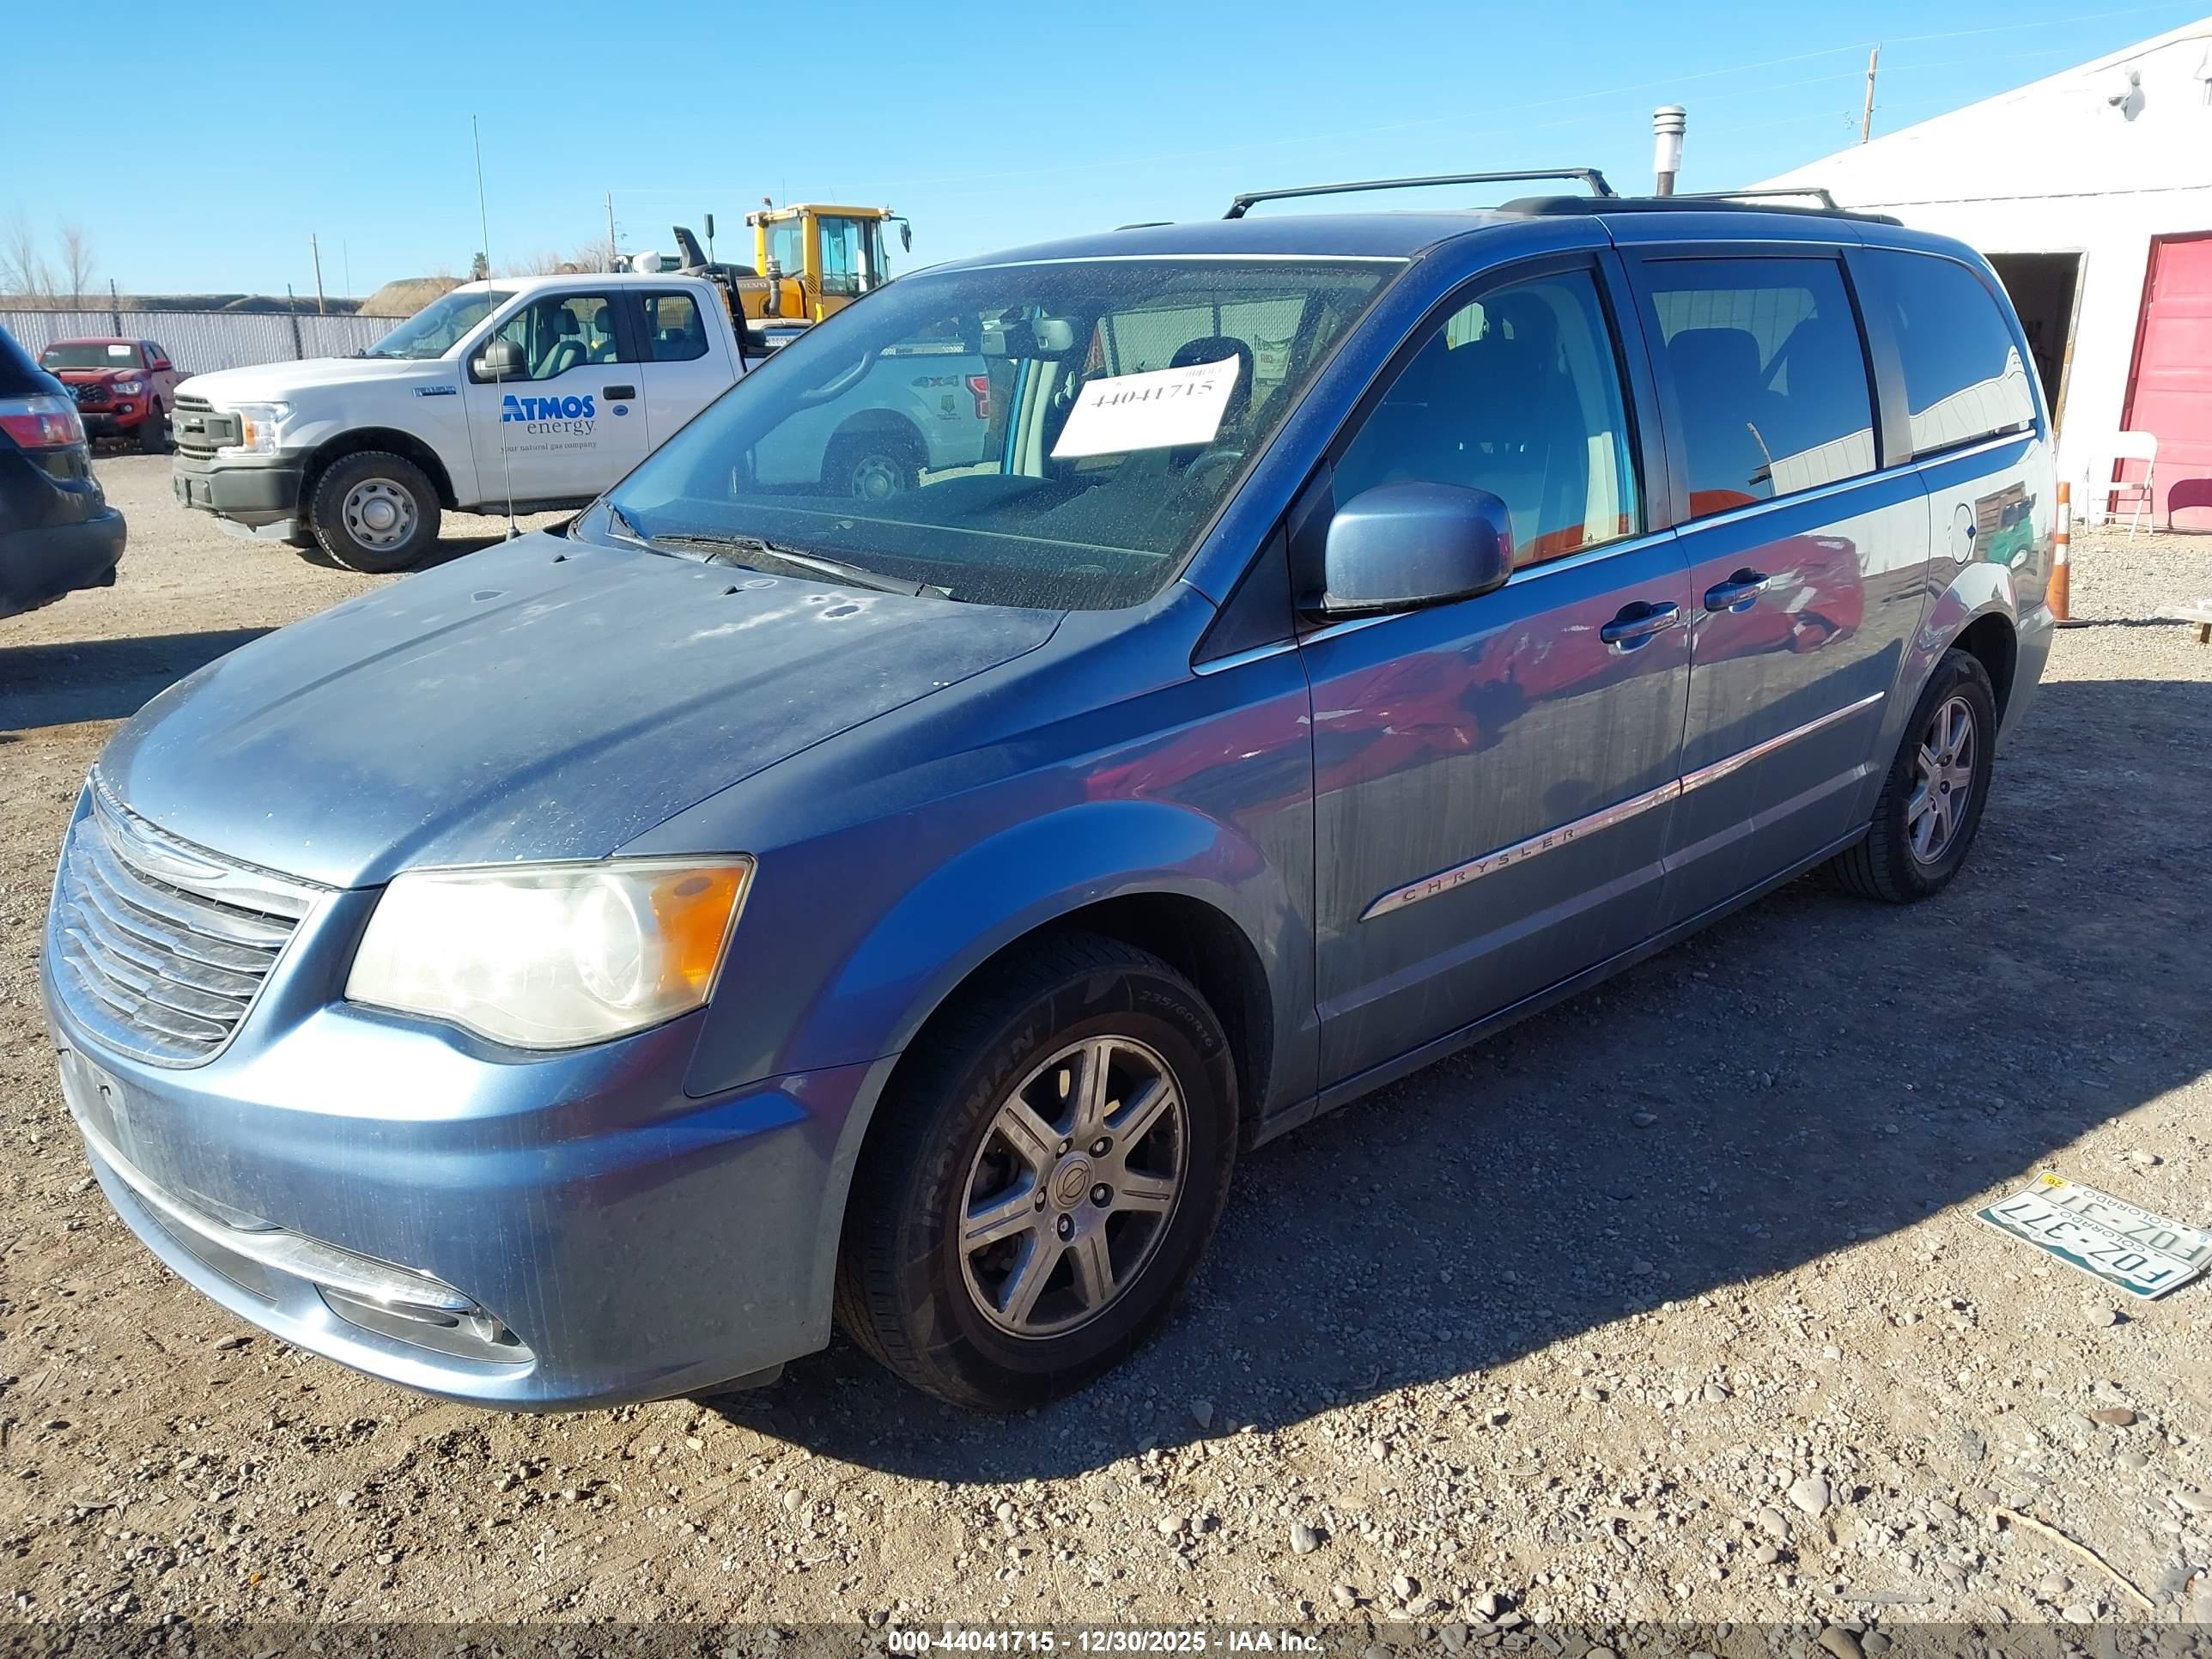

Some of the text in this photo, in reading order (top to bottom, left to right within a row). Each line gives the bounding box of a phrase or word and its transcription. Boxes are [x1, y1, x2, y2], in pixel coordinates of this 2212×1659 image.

[1091, 380, 1216, 409] 44041715
[527, 419, 595, 436] energy
[520, 442, 549, 452] natural
[565, 441, 597, 450] company
[1402, 829, 1575, 902] CHRYSLER
[1139, 989, 1213, 1048] 235/60R16
[2047, 1178, 2063, 1188] 26
[2082, 1190, 2173, 1229] COLORADO
[2059, 1211, 2146, 1253] COLORADO
